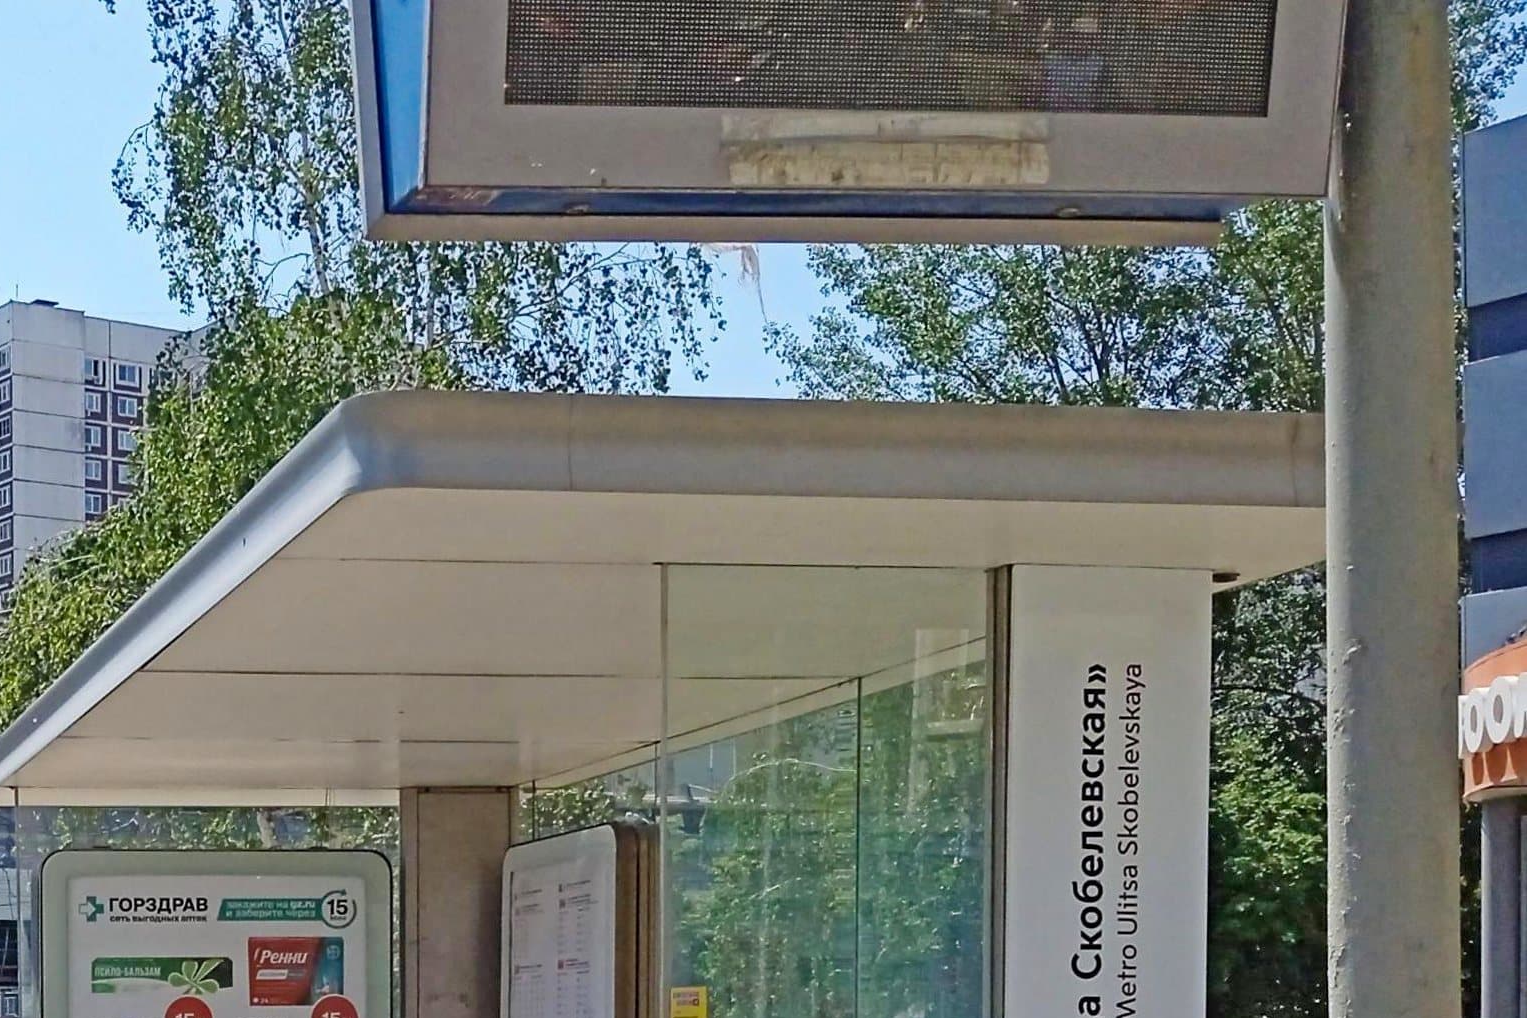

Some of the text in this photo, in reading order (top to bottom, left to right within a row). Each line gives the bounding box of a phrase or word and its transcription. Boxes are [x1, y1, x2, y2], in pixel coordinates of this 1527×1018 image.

[1118, 663, 1146, 856] Skobelevskaya
[1071, 663, 1107, 979] Скобелевская»
[108, 897, 208, 914] ГОРЗДРАВ
[327, 899, 348, 916] 15
[1117, 864, 1139, 936] Ulitsa
[259, 949, 308, 965] Ренни
